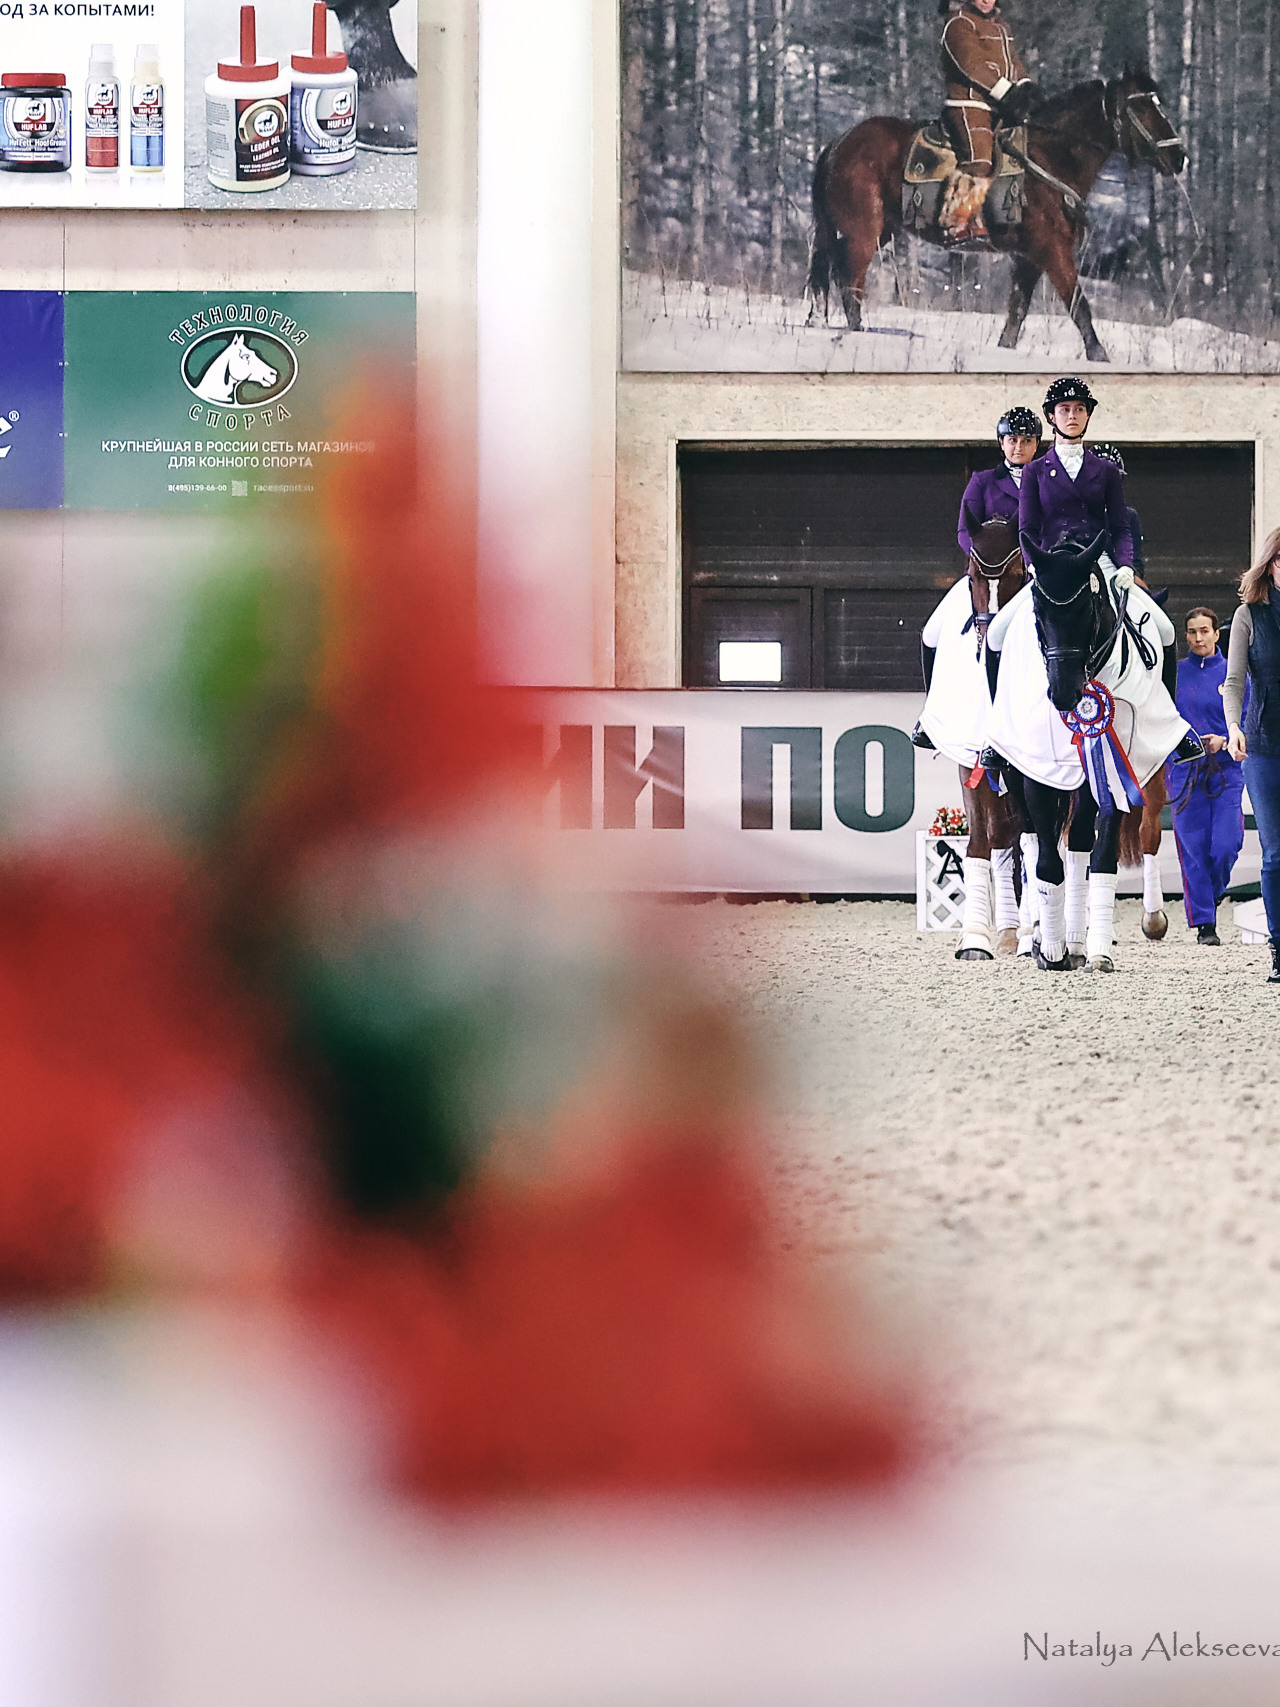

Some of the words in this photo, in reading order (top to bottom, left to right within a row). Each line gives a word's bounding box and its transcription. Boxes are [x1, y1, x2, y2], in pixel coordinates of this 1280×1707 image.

[29, 4, 49, 16] ЗА
[54, 4, 154, 17] КОПЫТАМИ!
[169, 304, 309, 346] ТЕХНОЛОГИЯ
[189, 404, 291, 430] СПОРТА
[101, 438, 191, 452] КРУПНЕЙШАЯ
[194, 440, 203, 452] В
[206, 440, 258, 452] РОССИИ
[262, 440, 294, 452] СЕТЬ
[167, 456, 196, 469] ДЛЯ
[199, 456, 259, 468] КОННОГО
[262, 456, 313, 468] СПОРТА
[740, 724, 916, 833] ПО
